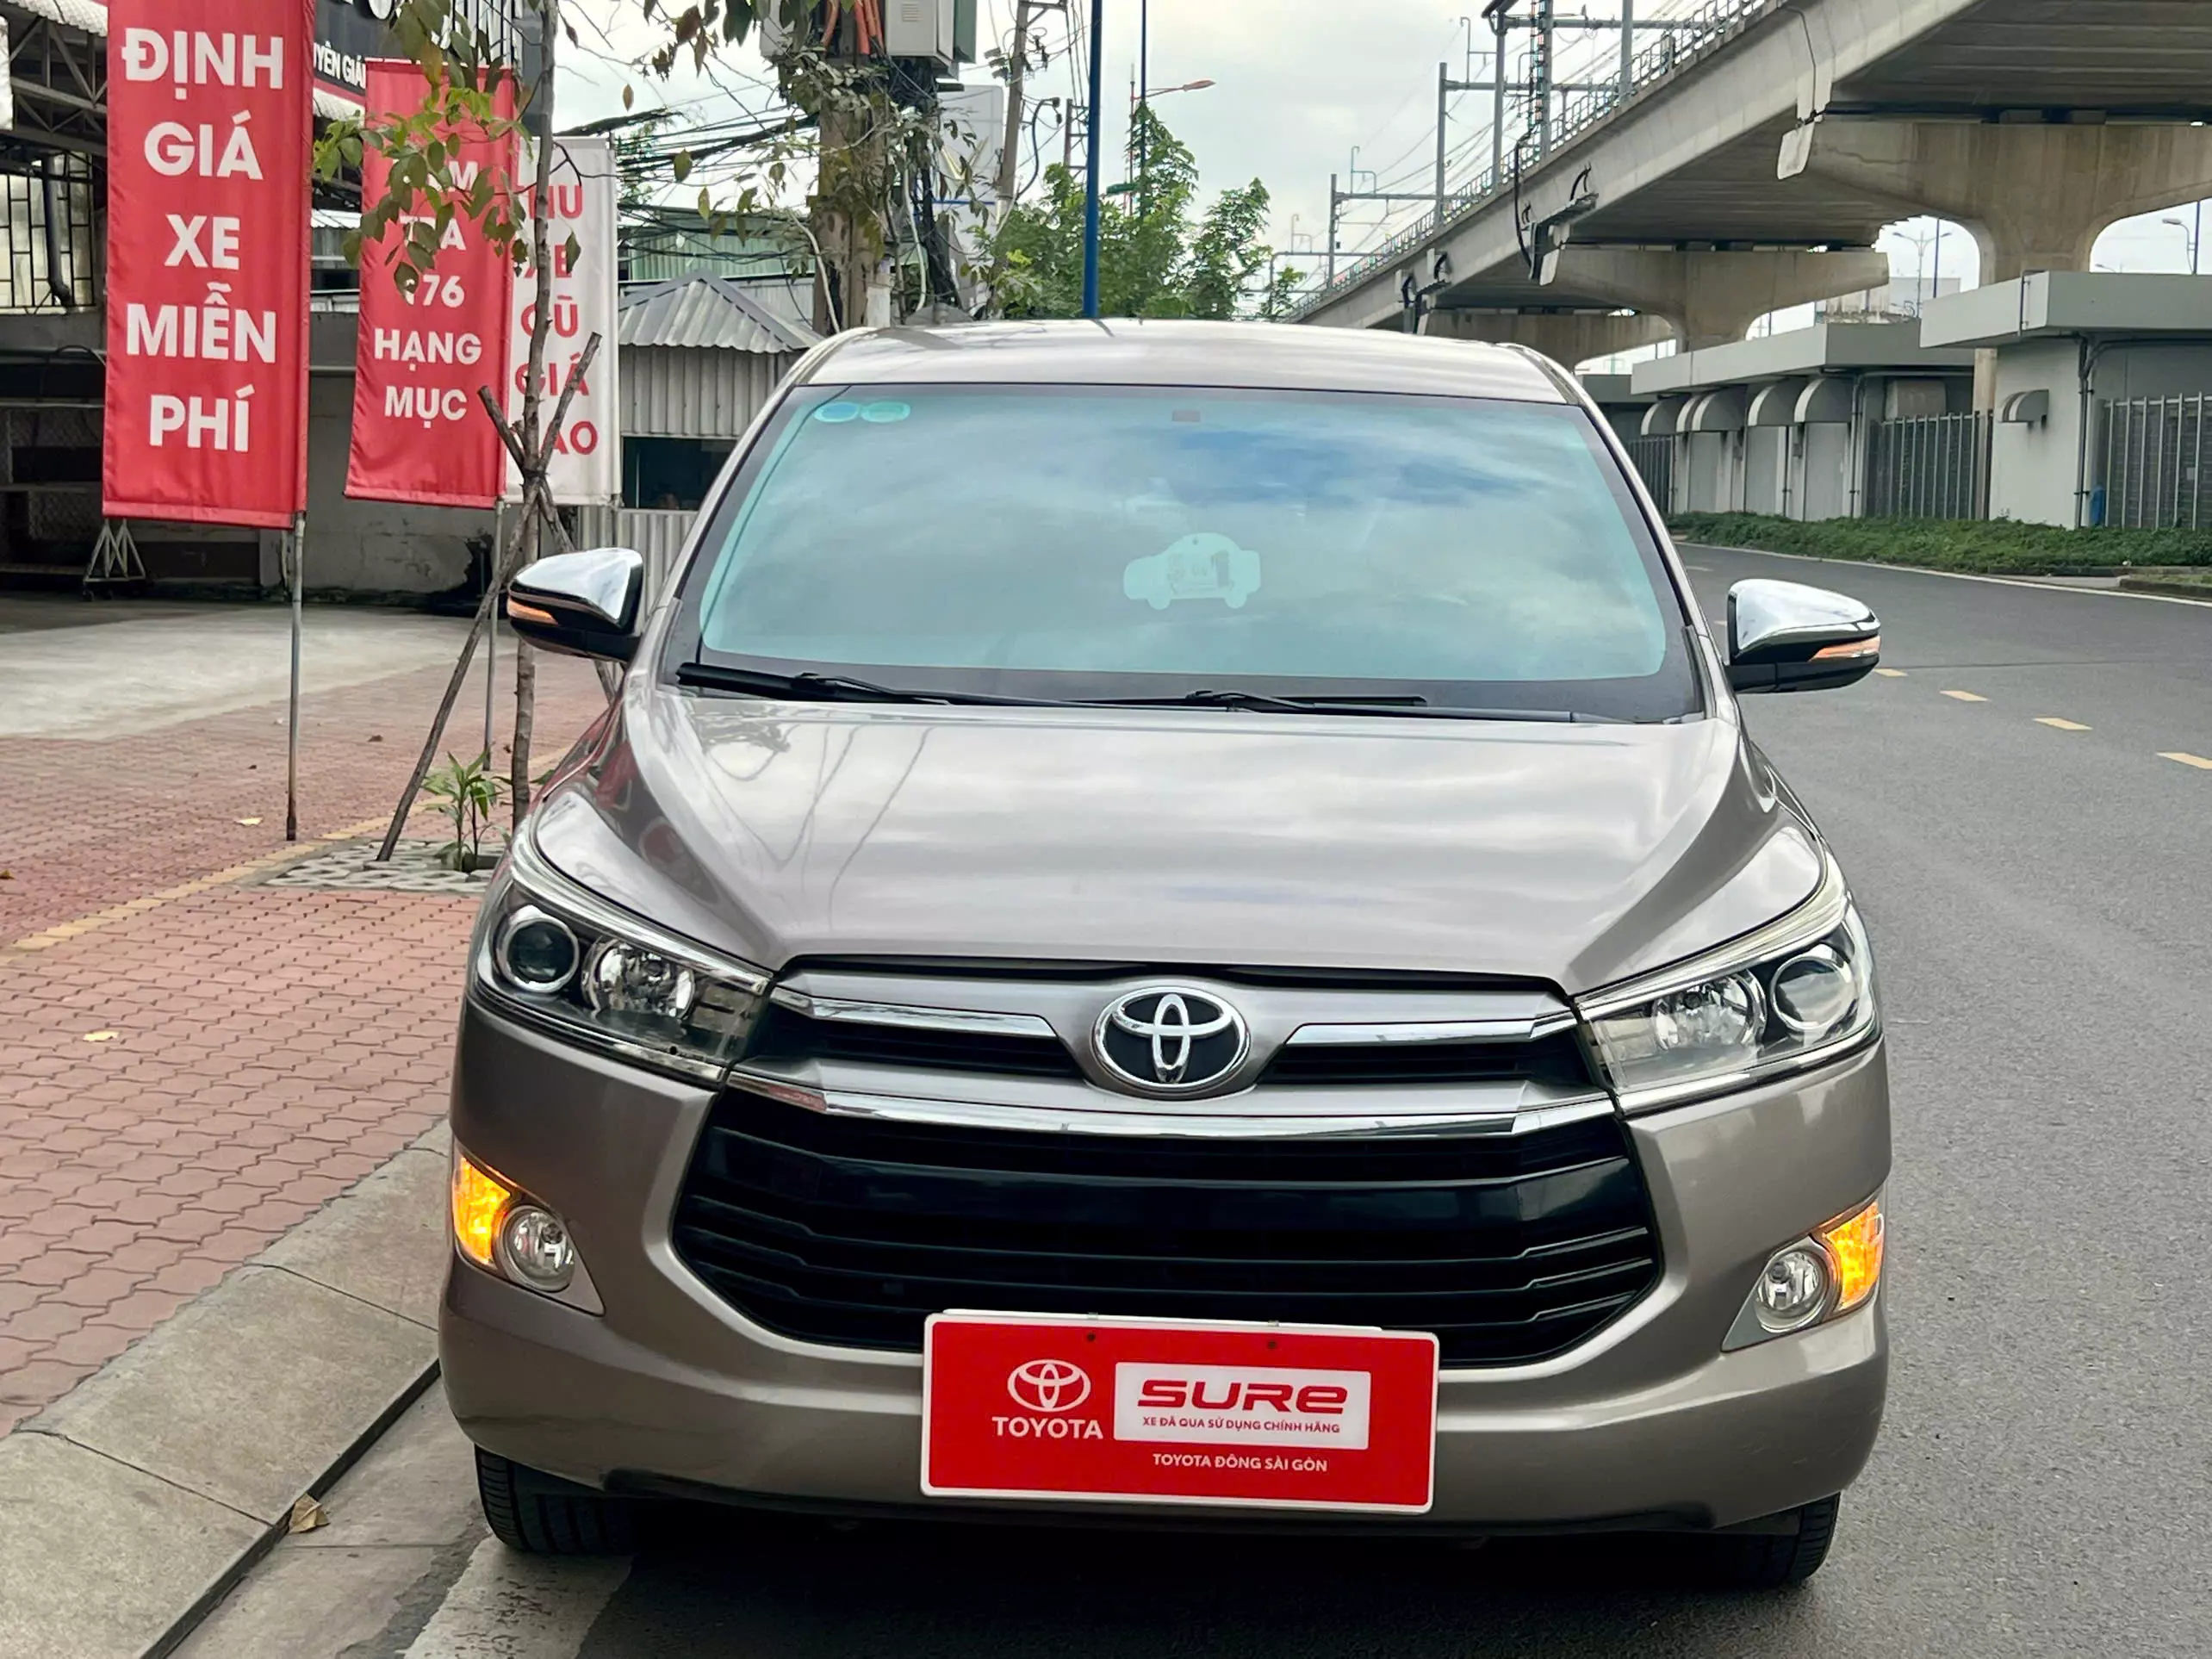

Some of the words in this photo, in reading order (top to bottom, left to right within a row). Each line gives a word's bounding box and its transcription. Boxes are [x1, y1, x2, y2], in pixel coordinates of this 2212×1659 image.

[121, 27, 283, 101] ĐỊNH
[144, 109, 264, 181] GIÁ
[517, 184, 583, 220] HU
[164, 214, 240, 270] XE
[126, 282, 277, 364] MIỄN
[374, 327, 482, 372] HẠNG
[149, 383, 256, 453] PHÍ
[384, 385, 467, 429] MỤC
[991, 1415, 1104, 1439] TOYOTA
[1142, 1416, 1157, 1426] XE
[1178, 1418, 1205, 1429] QUA
[1226, 1419, 1261, 1432] DỤNG
[1264, 1419, 1303, 1432] CHÍNH
[1153, 1453, 1212, 1468] TOYOTA
[1215, 1452, 1262, 1469] ĐÔNG
